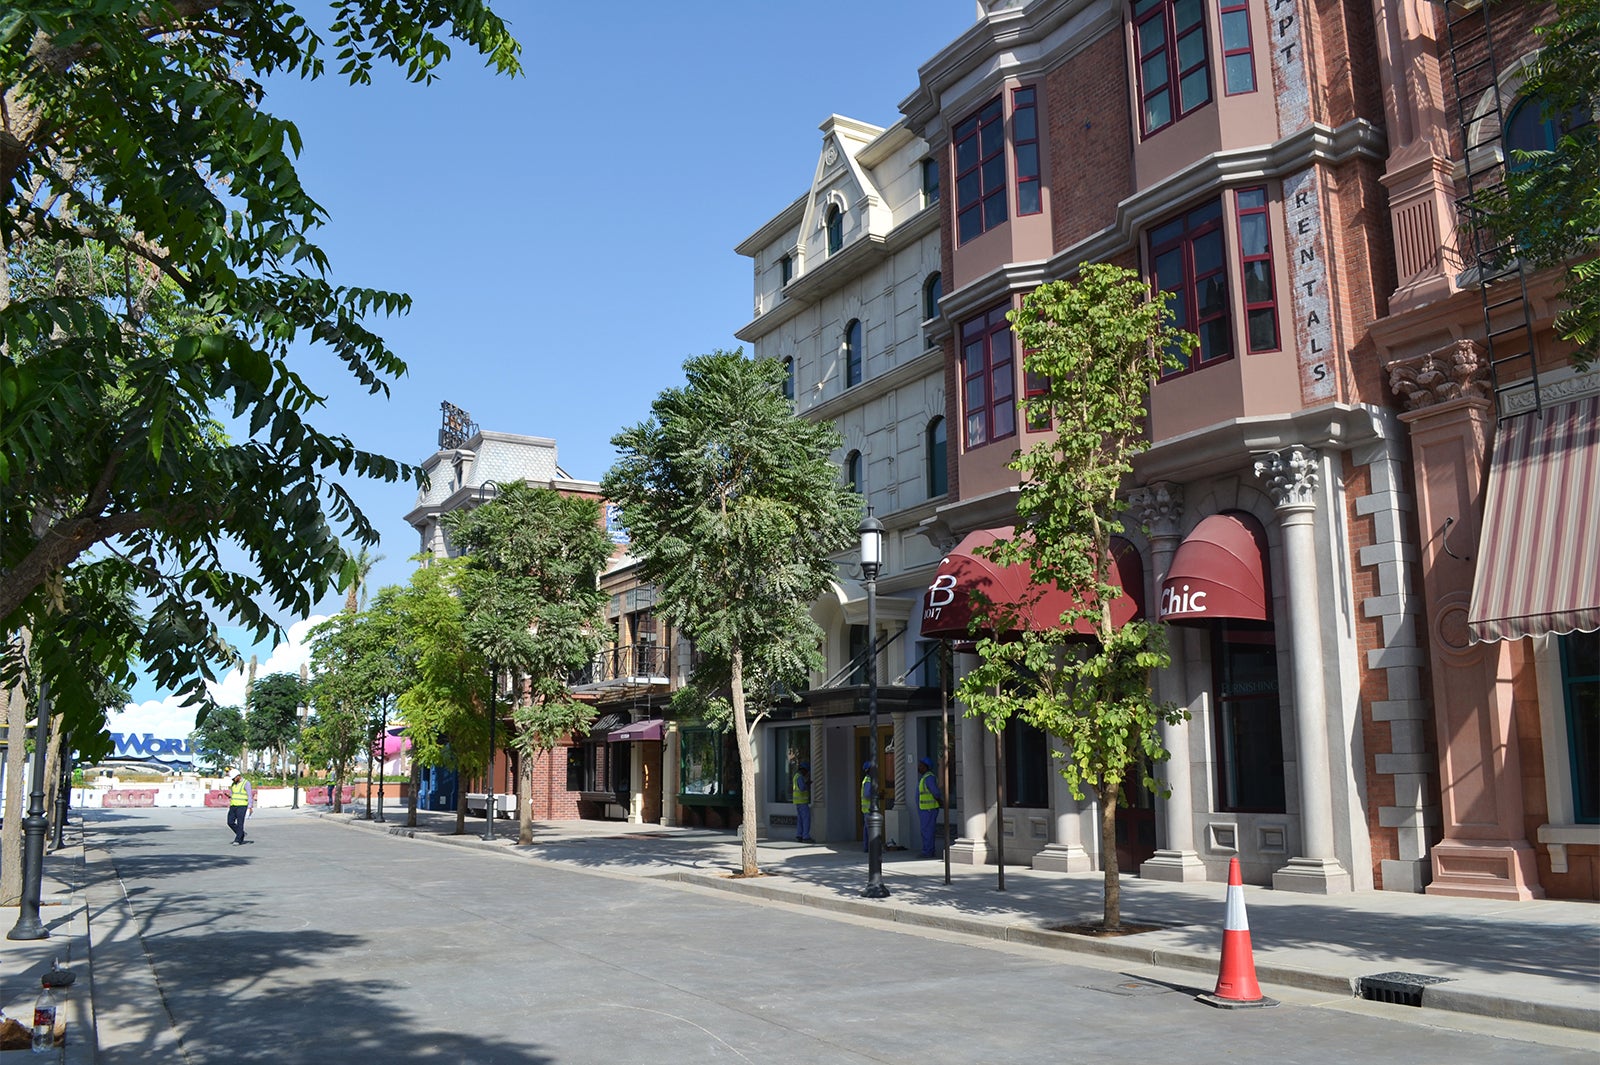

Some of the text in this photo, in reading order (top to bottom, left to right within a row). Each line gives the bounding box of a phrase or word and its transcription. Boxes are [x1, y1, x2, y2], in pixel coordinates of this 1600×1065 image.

[1295, 191, 1326, 381] RENTALS
[928, 574, 957, 607] B
[1160, 584, 1207, 616] Chic
